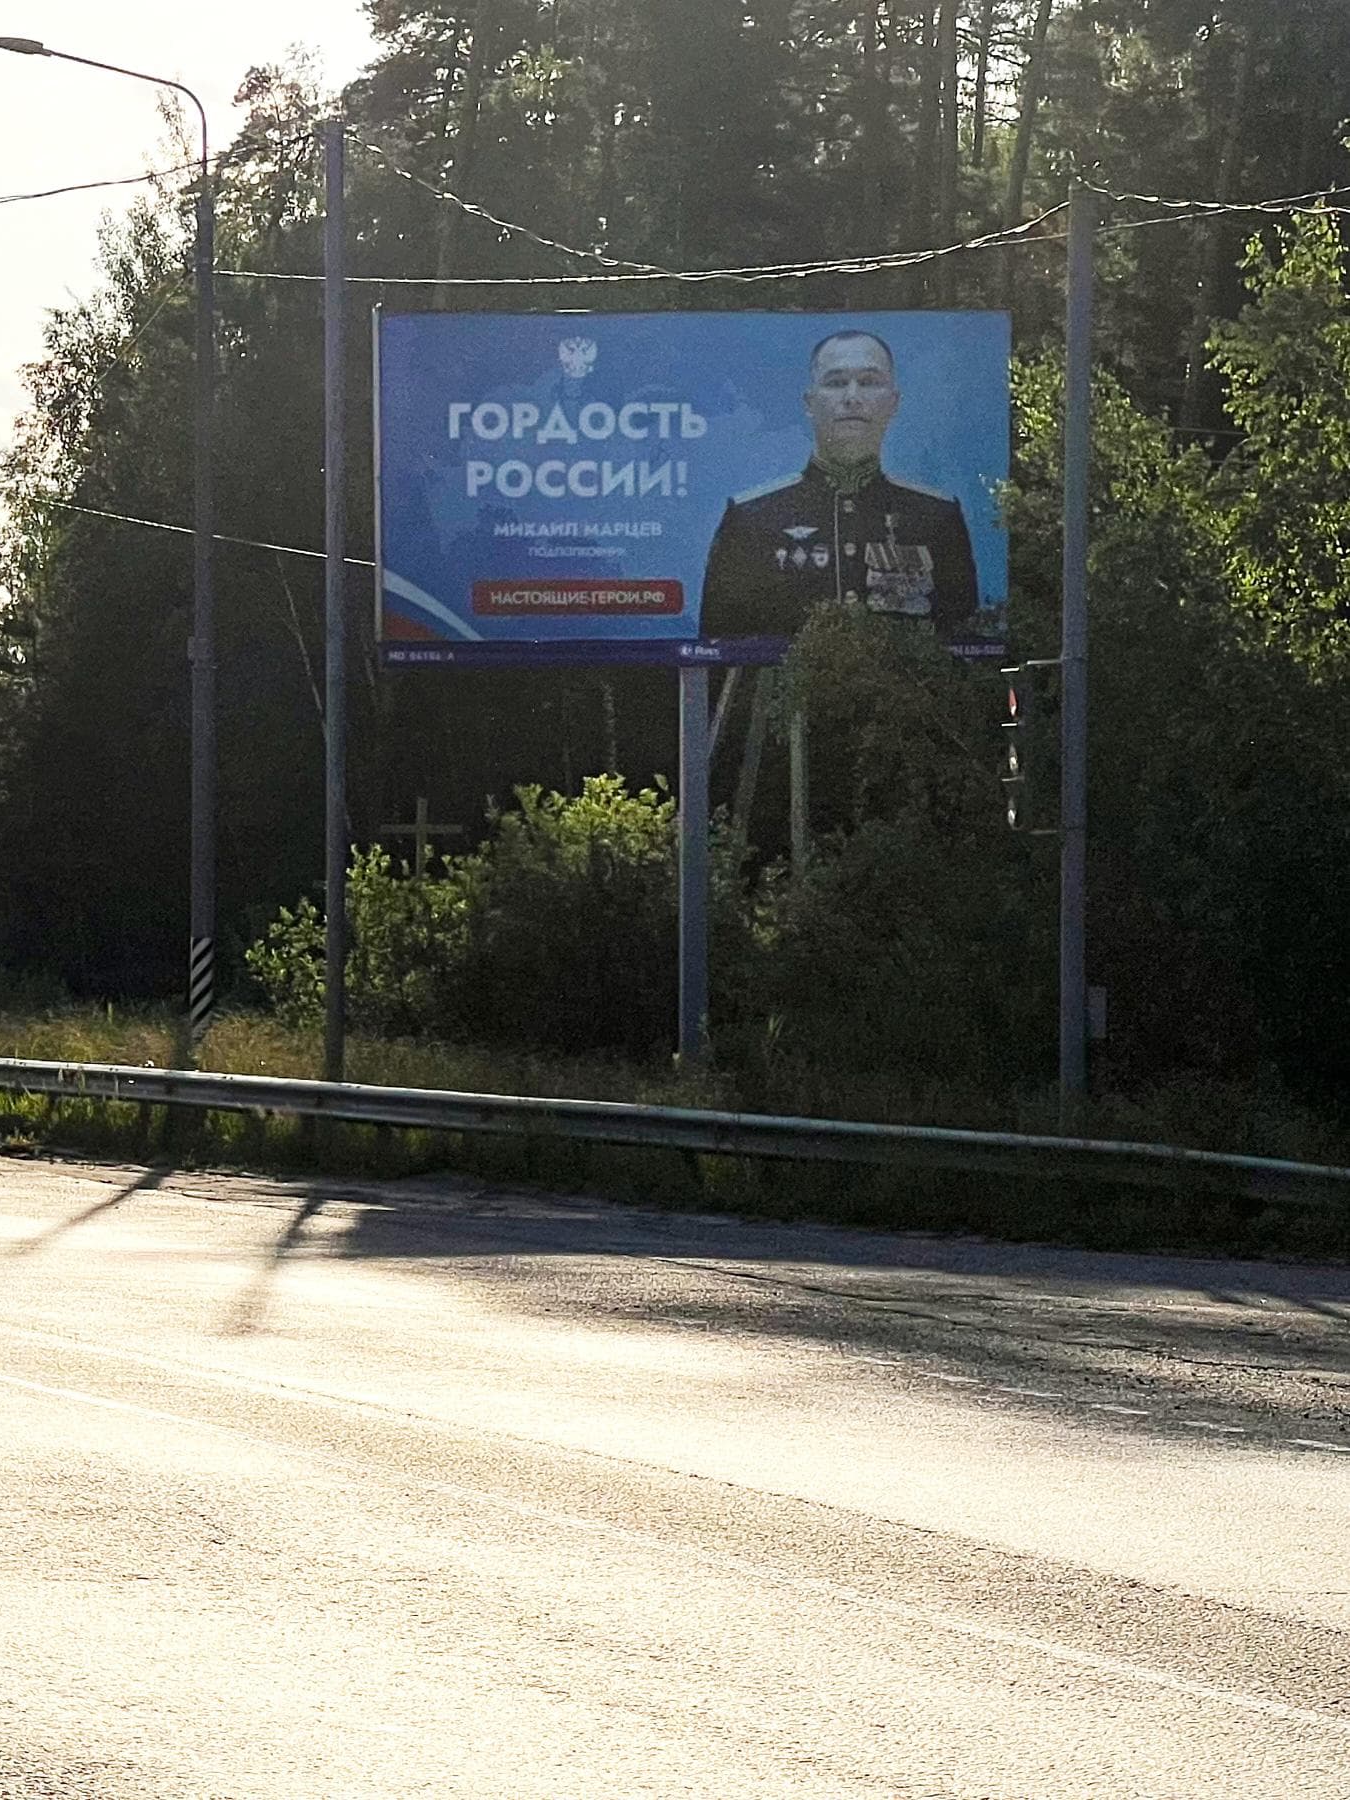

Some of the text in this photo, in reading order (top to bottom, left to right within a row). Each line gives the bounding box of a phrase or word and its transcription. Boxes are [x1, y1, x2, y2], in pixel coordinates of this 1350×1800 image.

[449, 402, 708, 444] ГОРДОСТЬ
[466, 459, 688, 498] РОССИИ!
[494, 522, 662, 538] МИХАИЛ МАРЦЕВ
